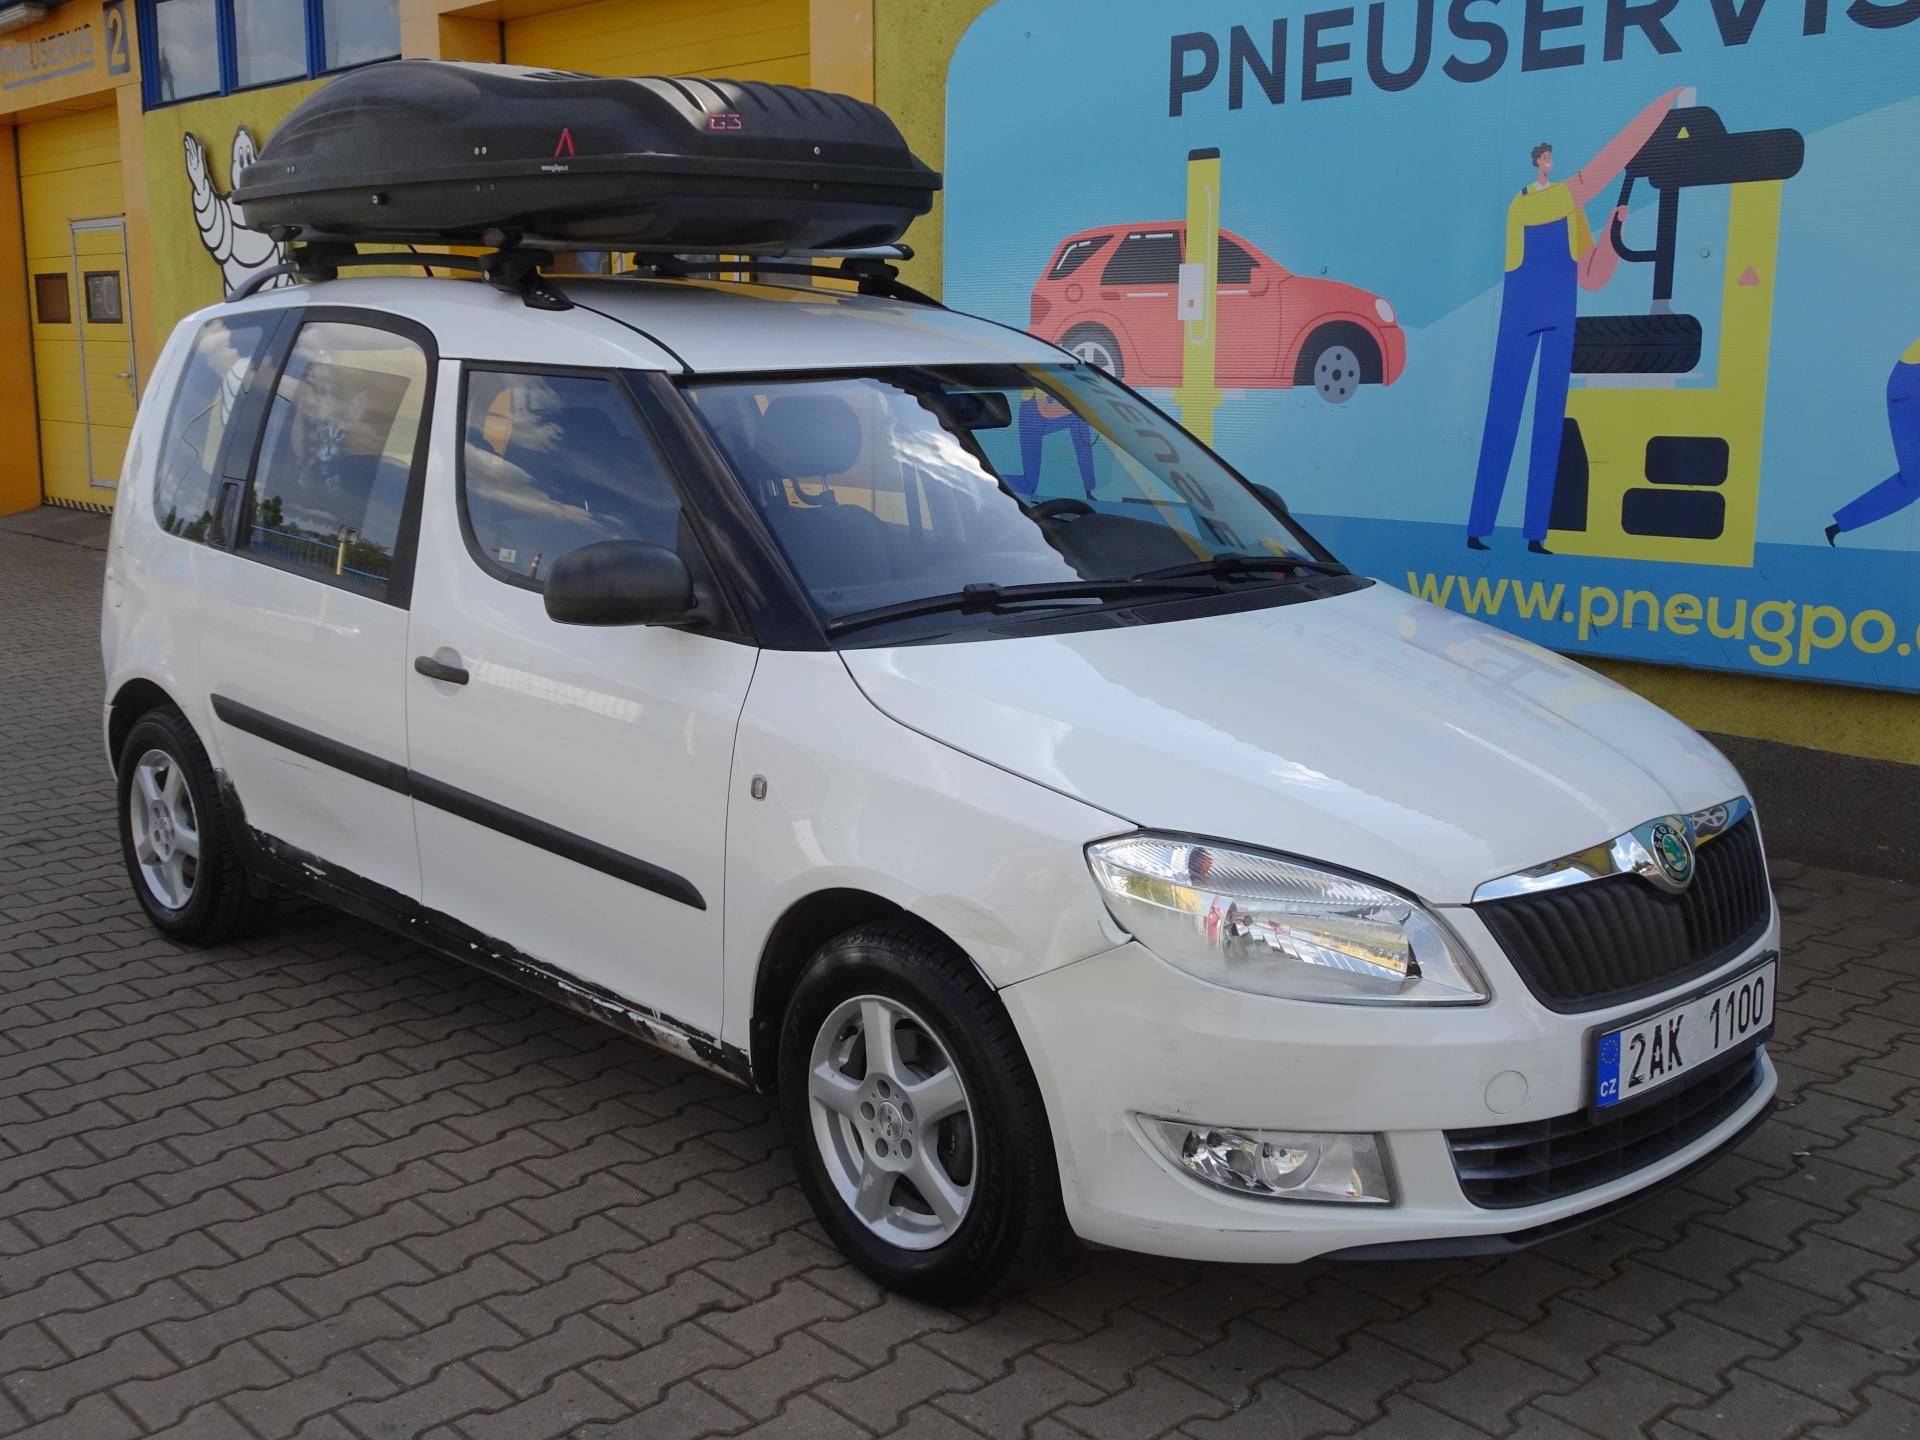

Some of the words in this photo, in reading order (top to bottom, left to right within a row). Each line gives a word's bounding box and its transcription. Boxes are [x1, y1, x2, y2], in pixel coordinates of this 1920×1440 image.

[109, 8, 126, 68] 2
[1168, 0, 1920, 118] PNEUSER
[707, 113, 742, 131] G3
[1406, 571, 1920, 667] www.pneugpo.
[1628, 1014, 1684, 1089] 2AK
[1709, 976, 1765, 1050] 1100
[1600, 1078, 1617, 1098] CZ
